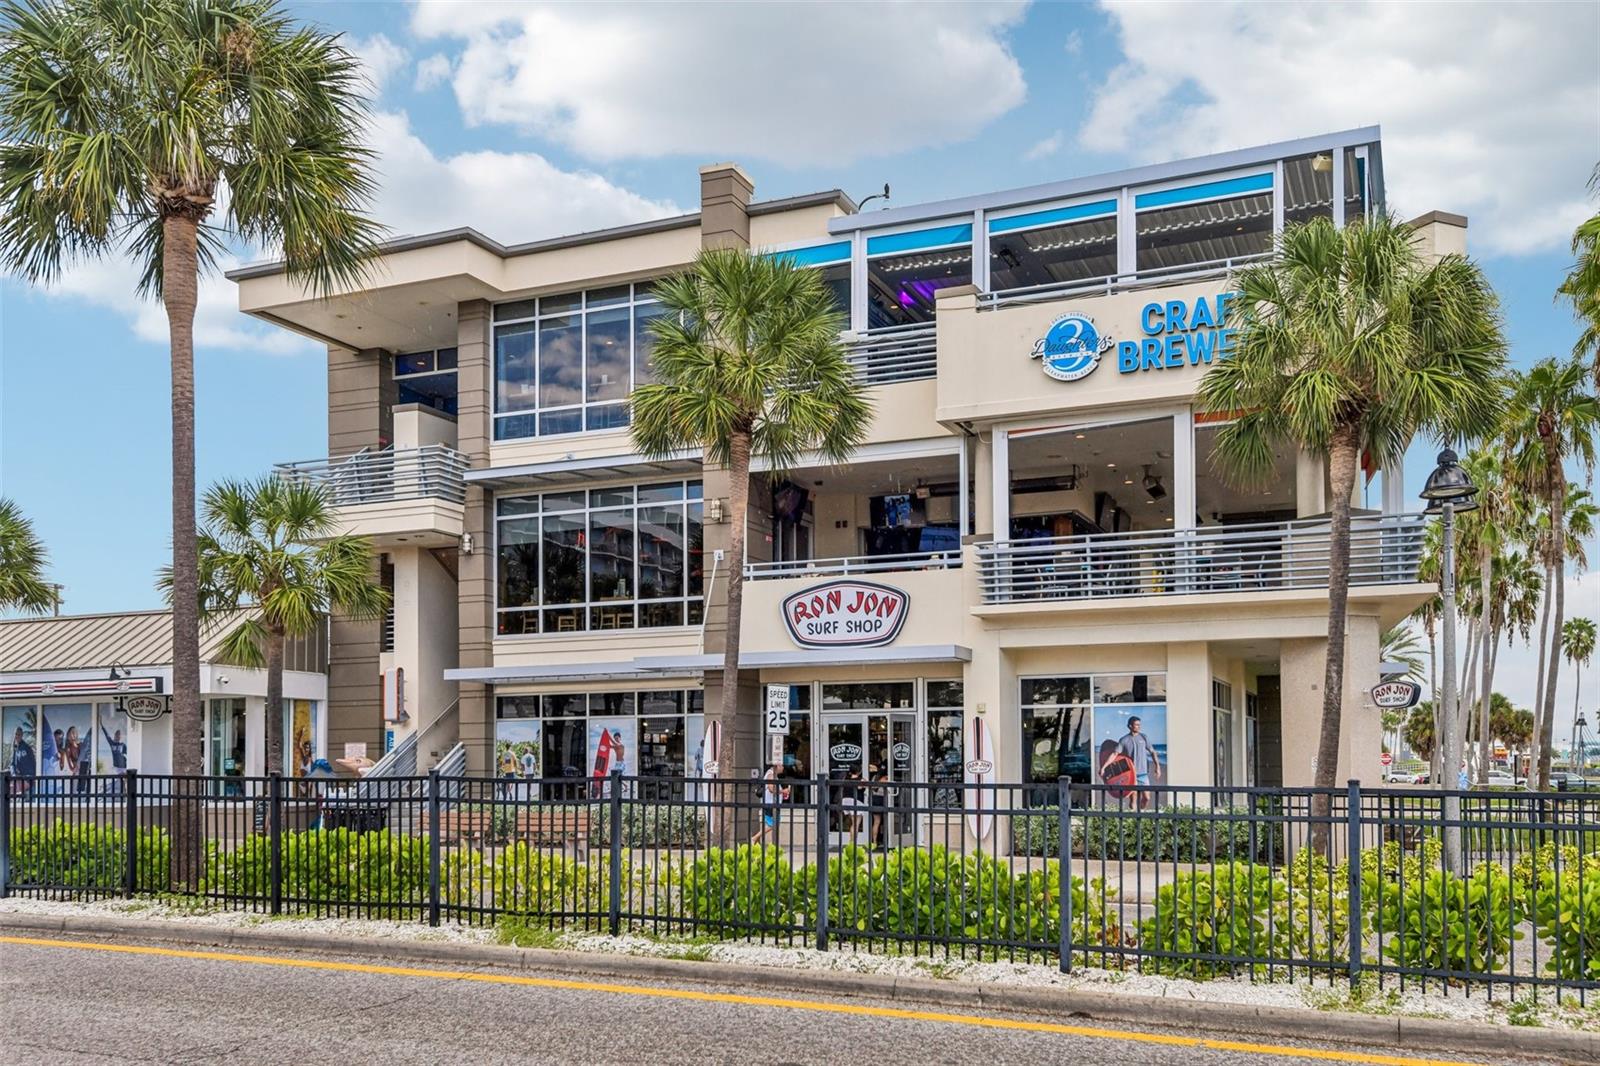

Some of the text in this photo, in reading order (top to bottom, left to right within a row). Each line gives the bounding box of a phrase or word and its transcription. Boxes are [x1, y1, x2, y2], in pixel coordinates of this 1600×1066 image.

[1141, 291, 1243, 335] CRAF
[1031, 331, 1113, 357] Daughters
[1118, 327, 1243, 374] BREWE
[794, 590, 898, 625] RON JON
[807, 619, 883, 635] SURF SHOP
[769, 690, 788, 700] SPEED
[1375, 685, 1410, 699] RON JON
[131, 699, 159, 710] RON JON
[770, 701, 787, 709] LIMIT
[768, 711, 788, 729] 25
[833, 746, 859, 755] RON JON
